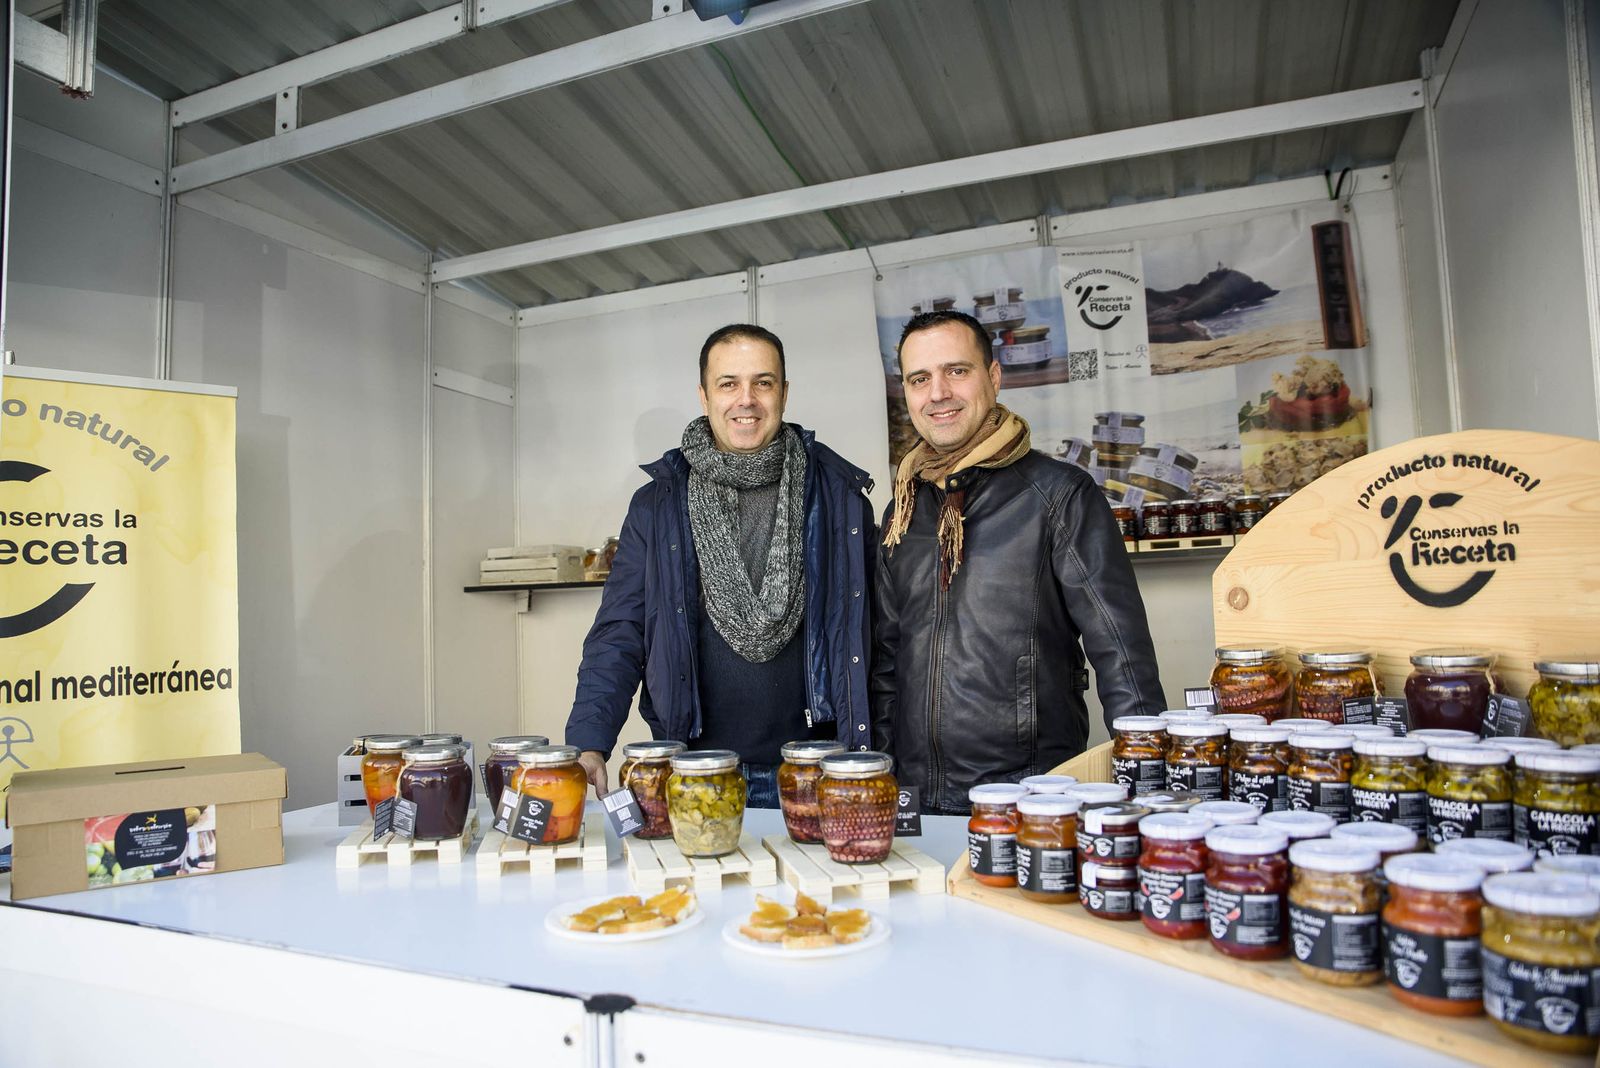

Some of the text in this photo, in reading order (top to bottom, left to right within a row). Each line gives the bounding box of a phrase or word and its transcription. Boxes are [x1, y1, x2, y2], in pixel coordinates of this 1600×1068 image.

[1064, 268, 1140, 289] producto natural
[1090, 302, 1131, 312] Receta
[39, 402, 170, 472] natural
[1357, 453, 1541, 509] producto natural
[114, 509, 137, 529] la
[1410, 520, 1519, 541] Conservas la
[1411, 539, 1516, 566] Receta
[51, 661, 232, 700] mediterránea
[1352, 788, 1397, 803] CARACOLA
[1364, 799, 1390, 810] RECETA
[1429, 797, 1480, 814] CARACOLA
[1442, 808, 1473, 821] RECETA
[1530, 810, 1595, 826] CARACOLA
[1550, 822, 1588, 834] RECETA
